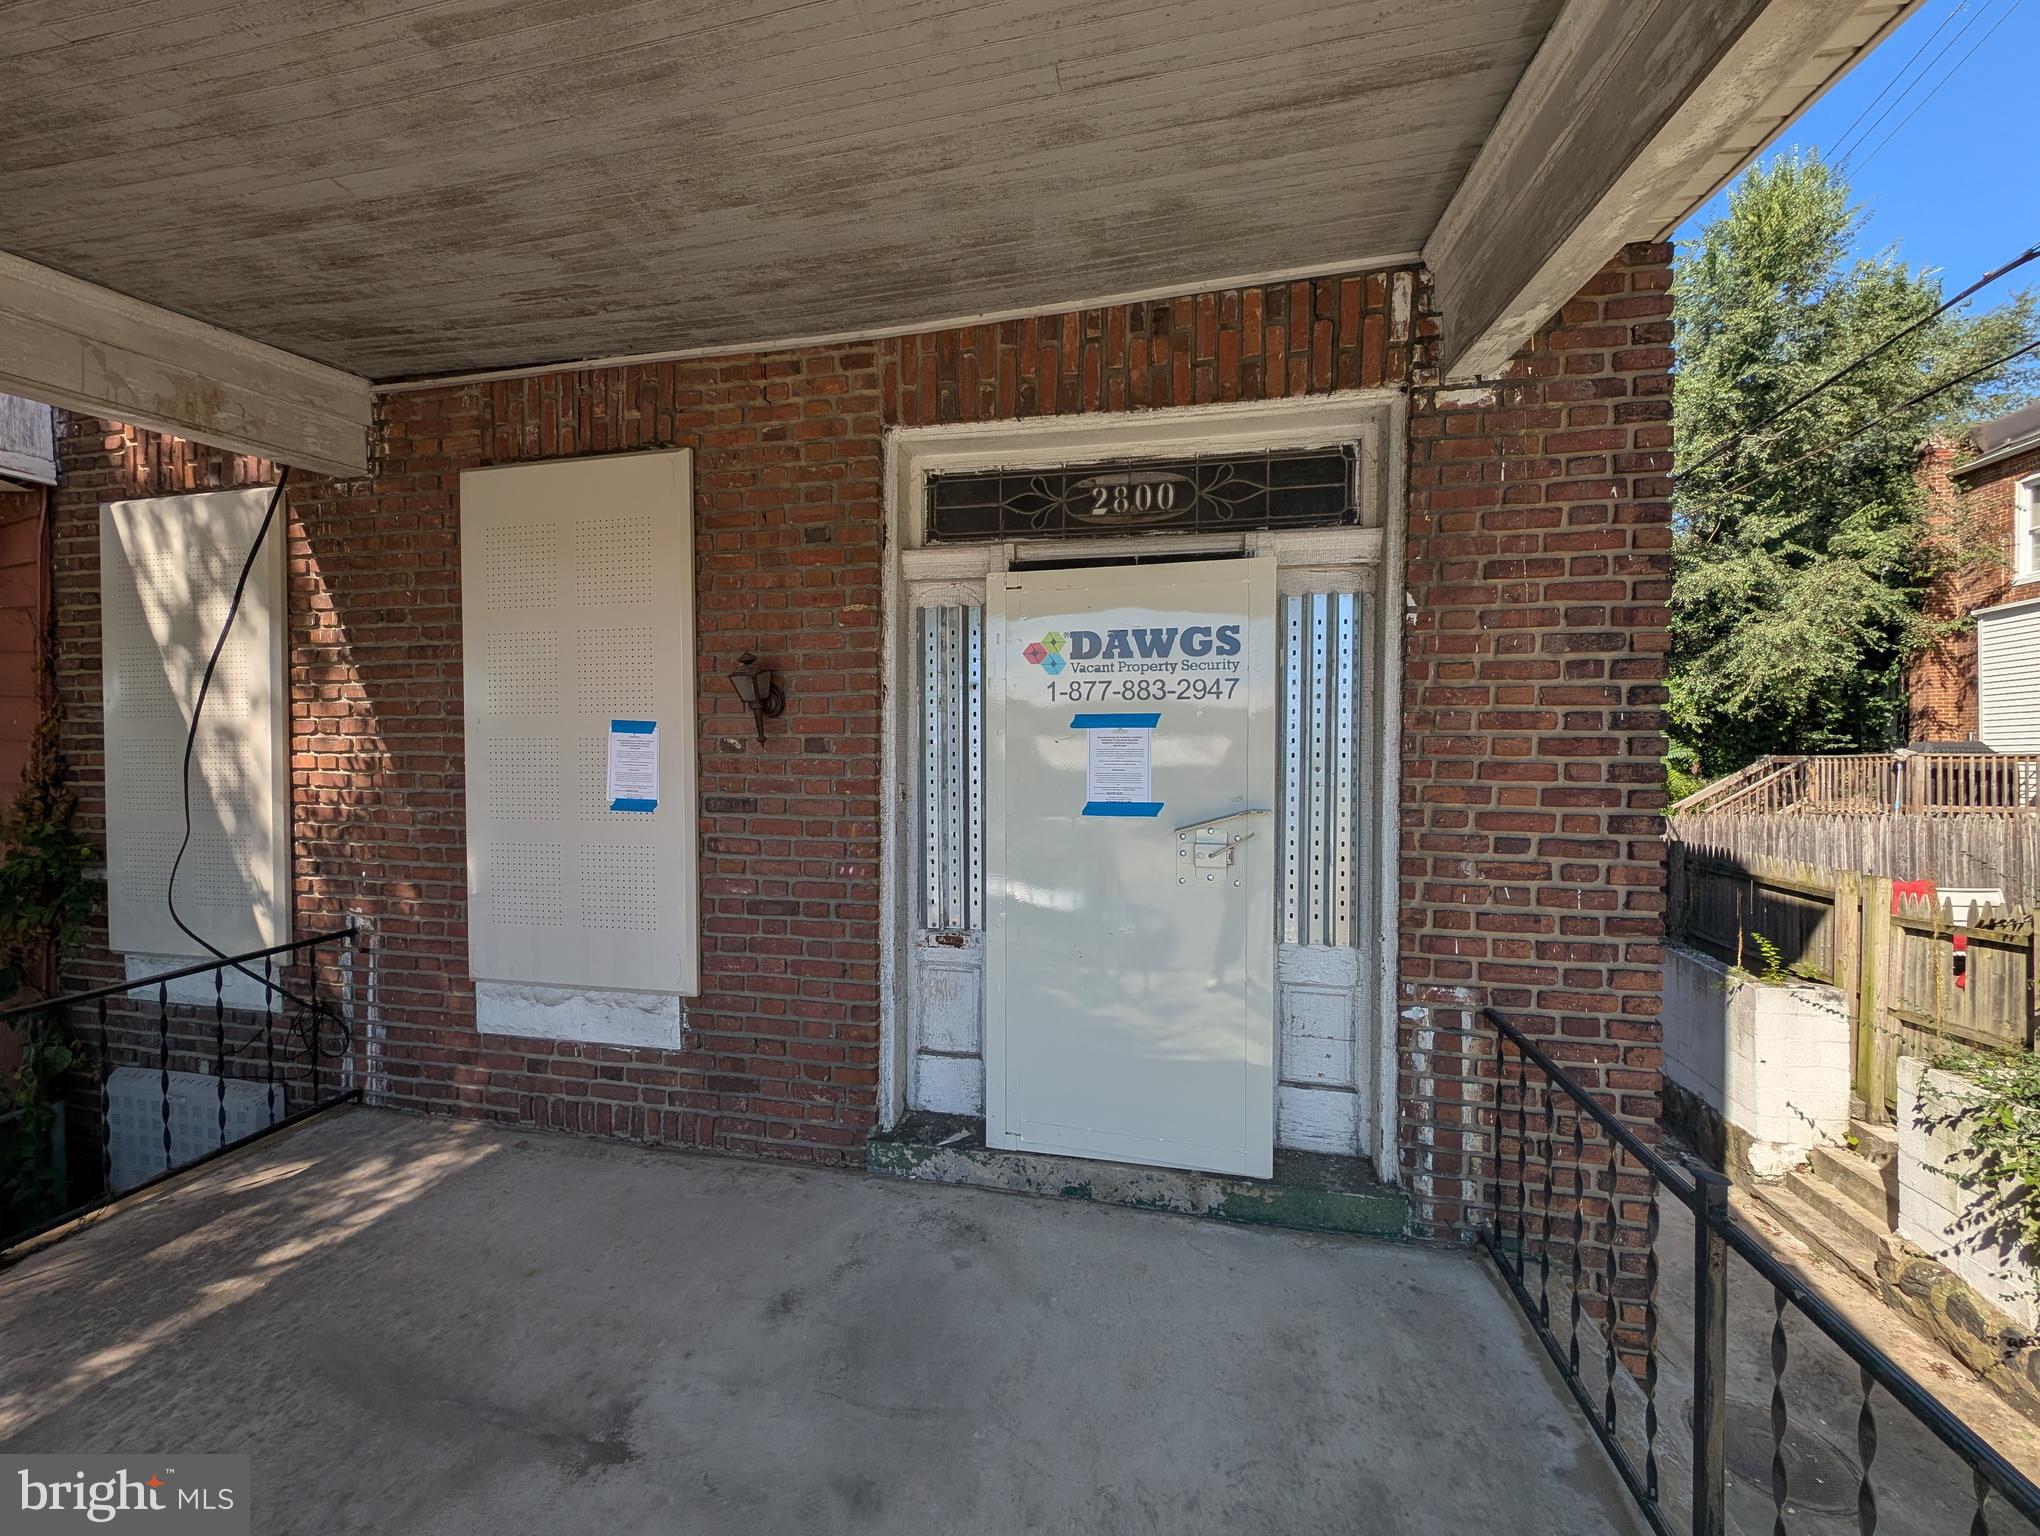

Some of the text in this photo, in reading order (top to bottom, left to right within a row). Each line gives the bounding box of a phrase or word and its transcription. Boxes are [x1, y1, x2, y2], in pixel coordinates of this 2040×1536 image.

[1091, 482, 1175, 516] 2800
[1069, 625, 1241, 660] DAWGS
[1070, 659, 1240, 675] Vacant Property Security
[1047, 678, 1240, 702] 1-877-883-2947
